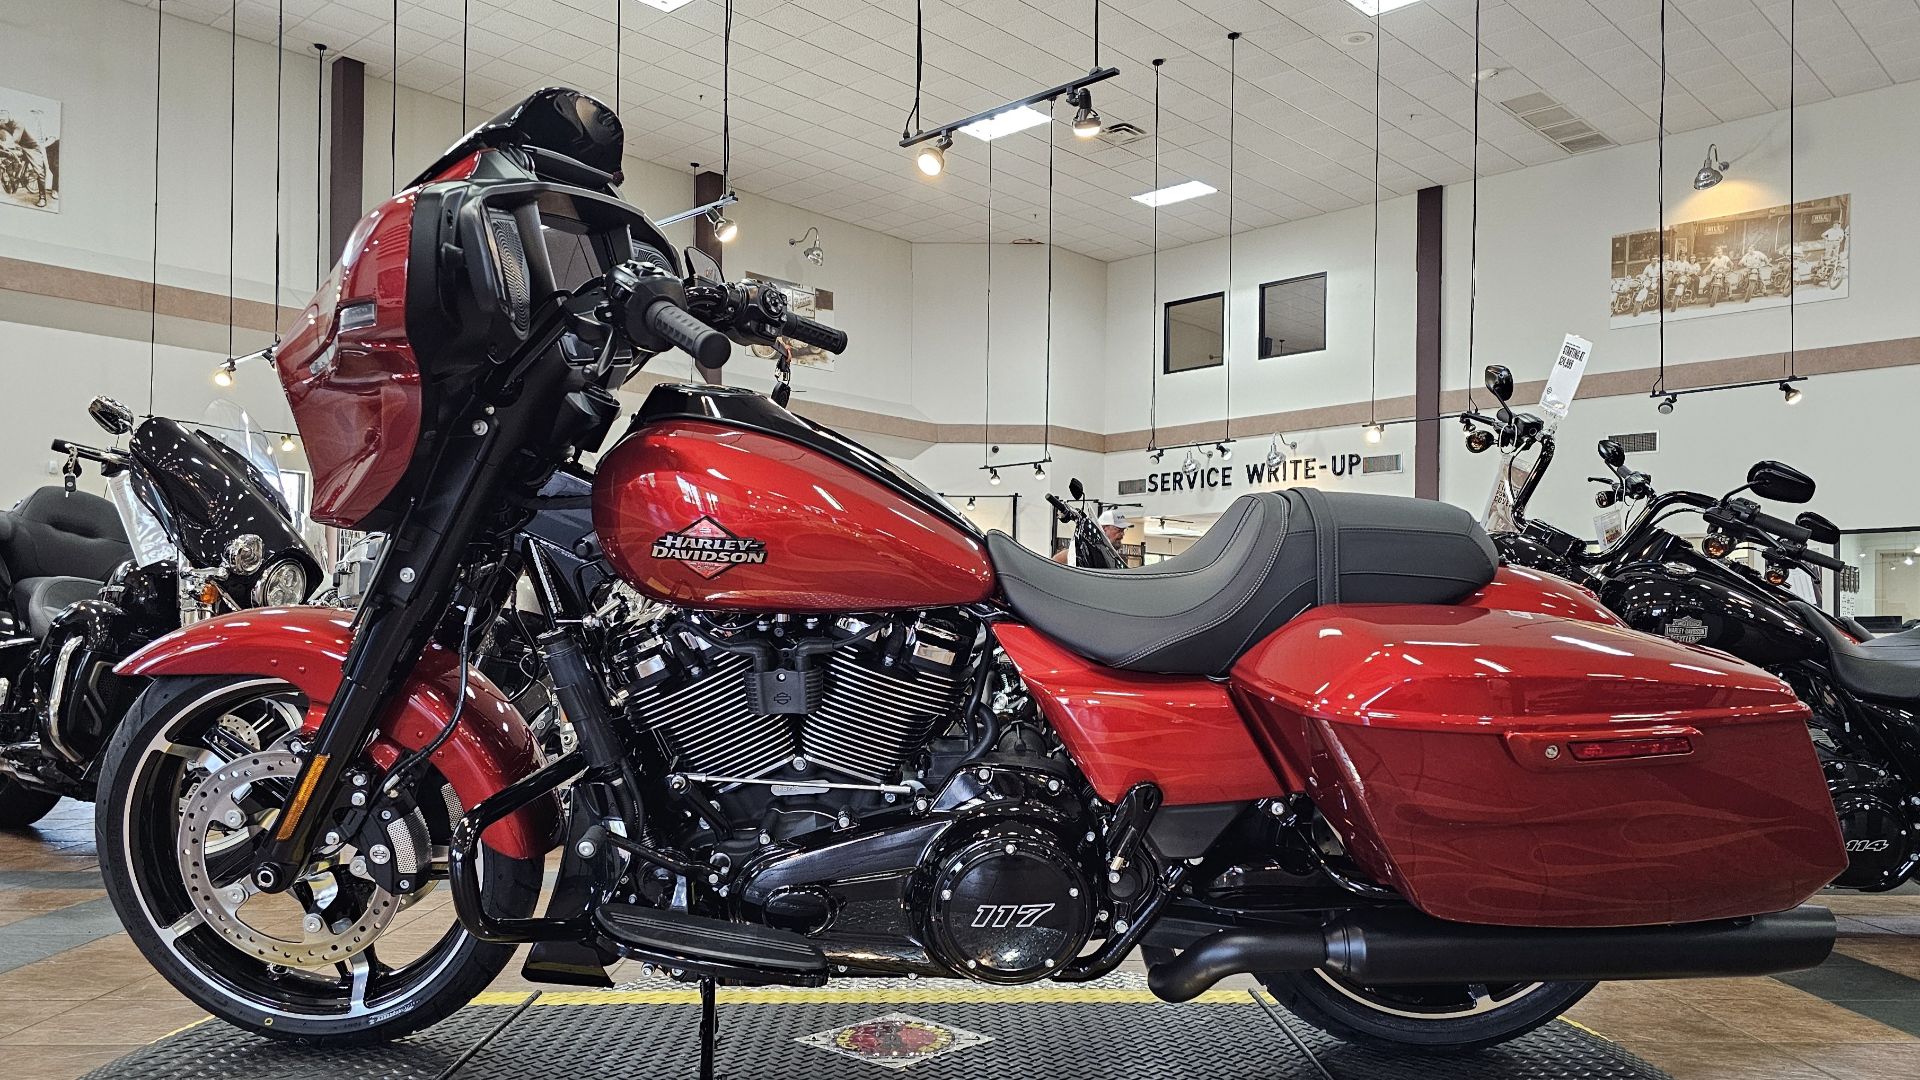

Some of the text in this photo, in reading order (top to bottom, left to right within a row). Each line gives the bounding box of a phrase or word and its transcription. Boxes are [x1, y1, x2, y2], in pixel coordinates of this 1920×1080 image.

[1147, 453, 1362, 493] SERVICE WRITE-UP
[658, 535, 760, 551] HARLEY-
[651, 545, 766, 564] DAVIDSON
[1845, 839, 1890, 852] 114
[970, 902, 1056, 928] 117
